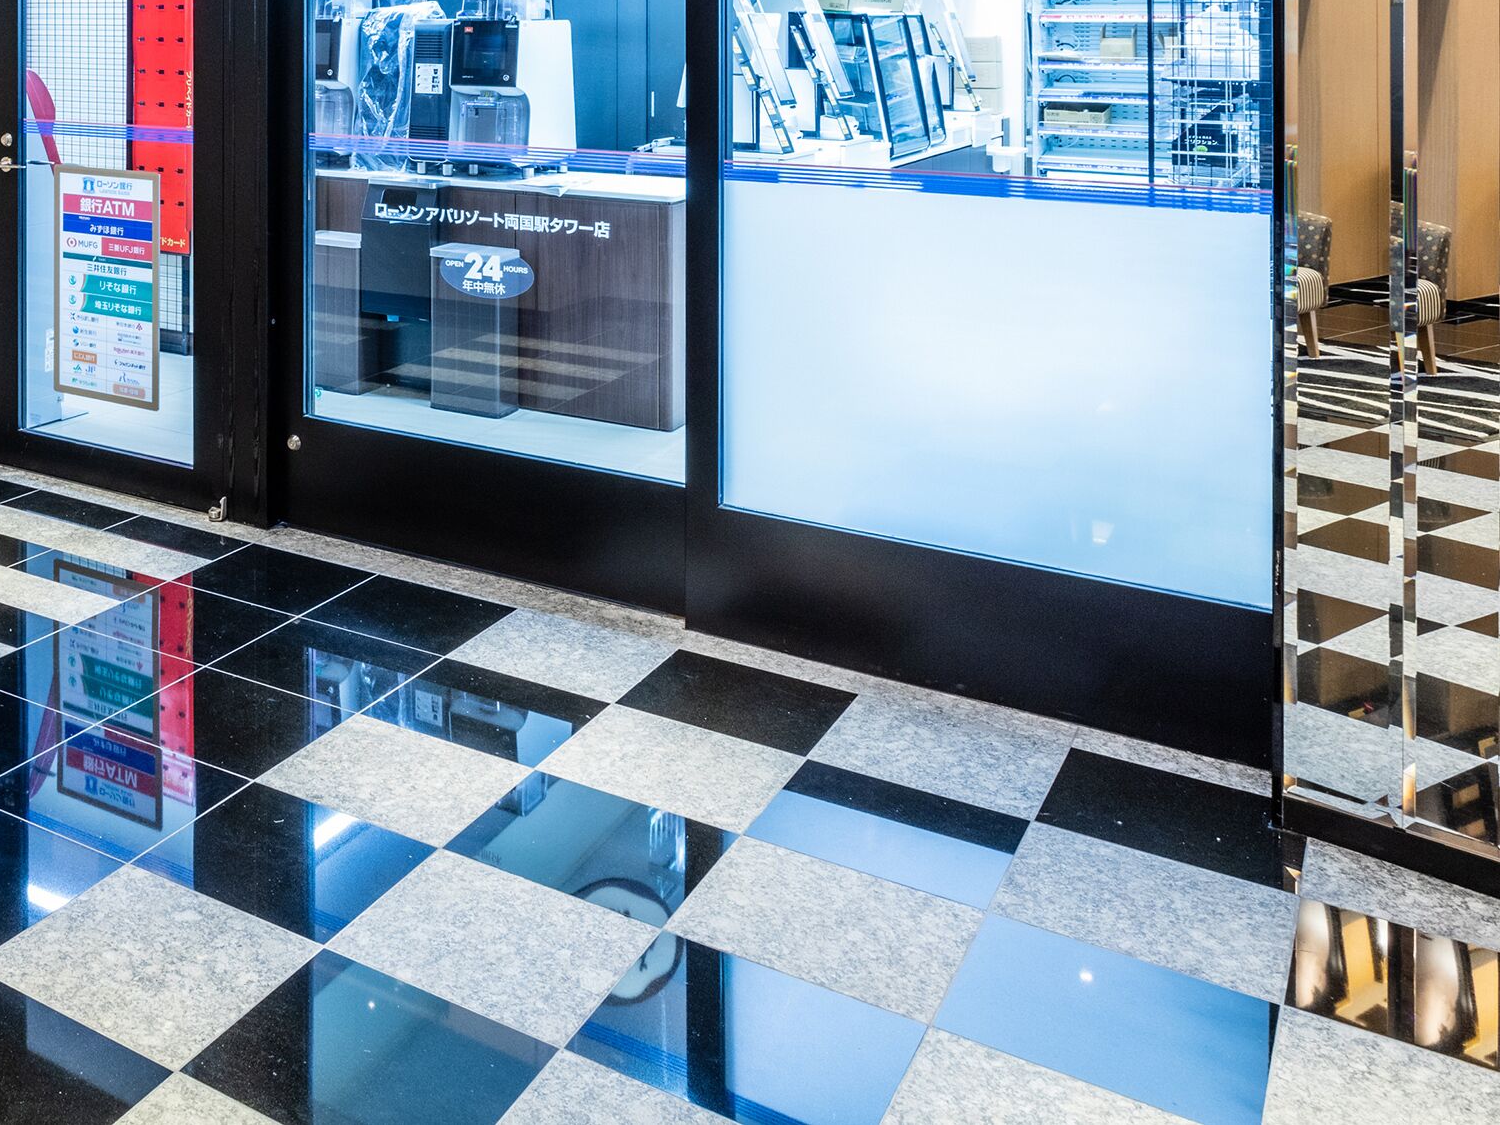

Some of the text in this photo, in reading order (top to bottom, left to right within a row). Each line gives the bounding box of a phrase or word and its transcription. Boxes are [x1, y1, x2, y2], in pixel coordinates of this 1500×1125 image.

[96, 180, 133, 191] ローソン銀行
[80, 197, 135, 217] 銀行ATM
[375, 202, 611, 238] ローソンアパリゾート両国駅タワー店
[89, 223, 124, 236] みずほ銀行
[78, 239, 98, 249] MUFG
[108, 243, 145, 255] 三菱UFJ銀行
[87, 263, 127, 276] 三井住友銀行
[445, 252, 529, 282] OPEN 24 HOURS
[99, 280, 137, 295] りそな銀行
[462, 279, 506, 295] 年中無休
[94, 300, 142, 315] 埼玉りそな銀行
